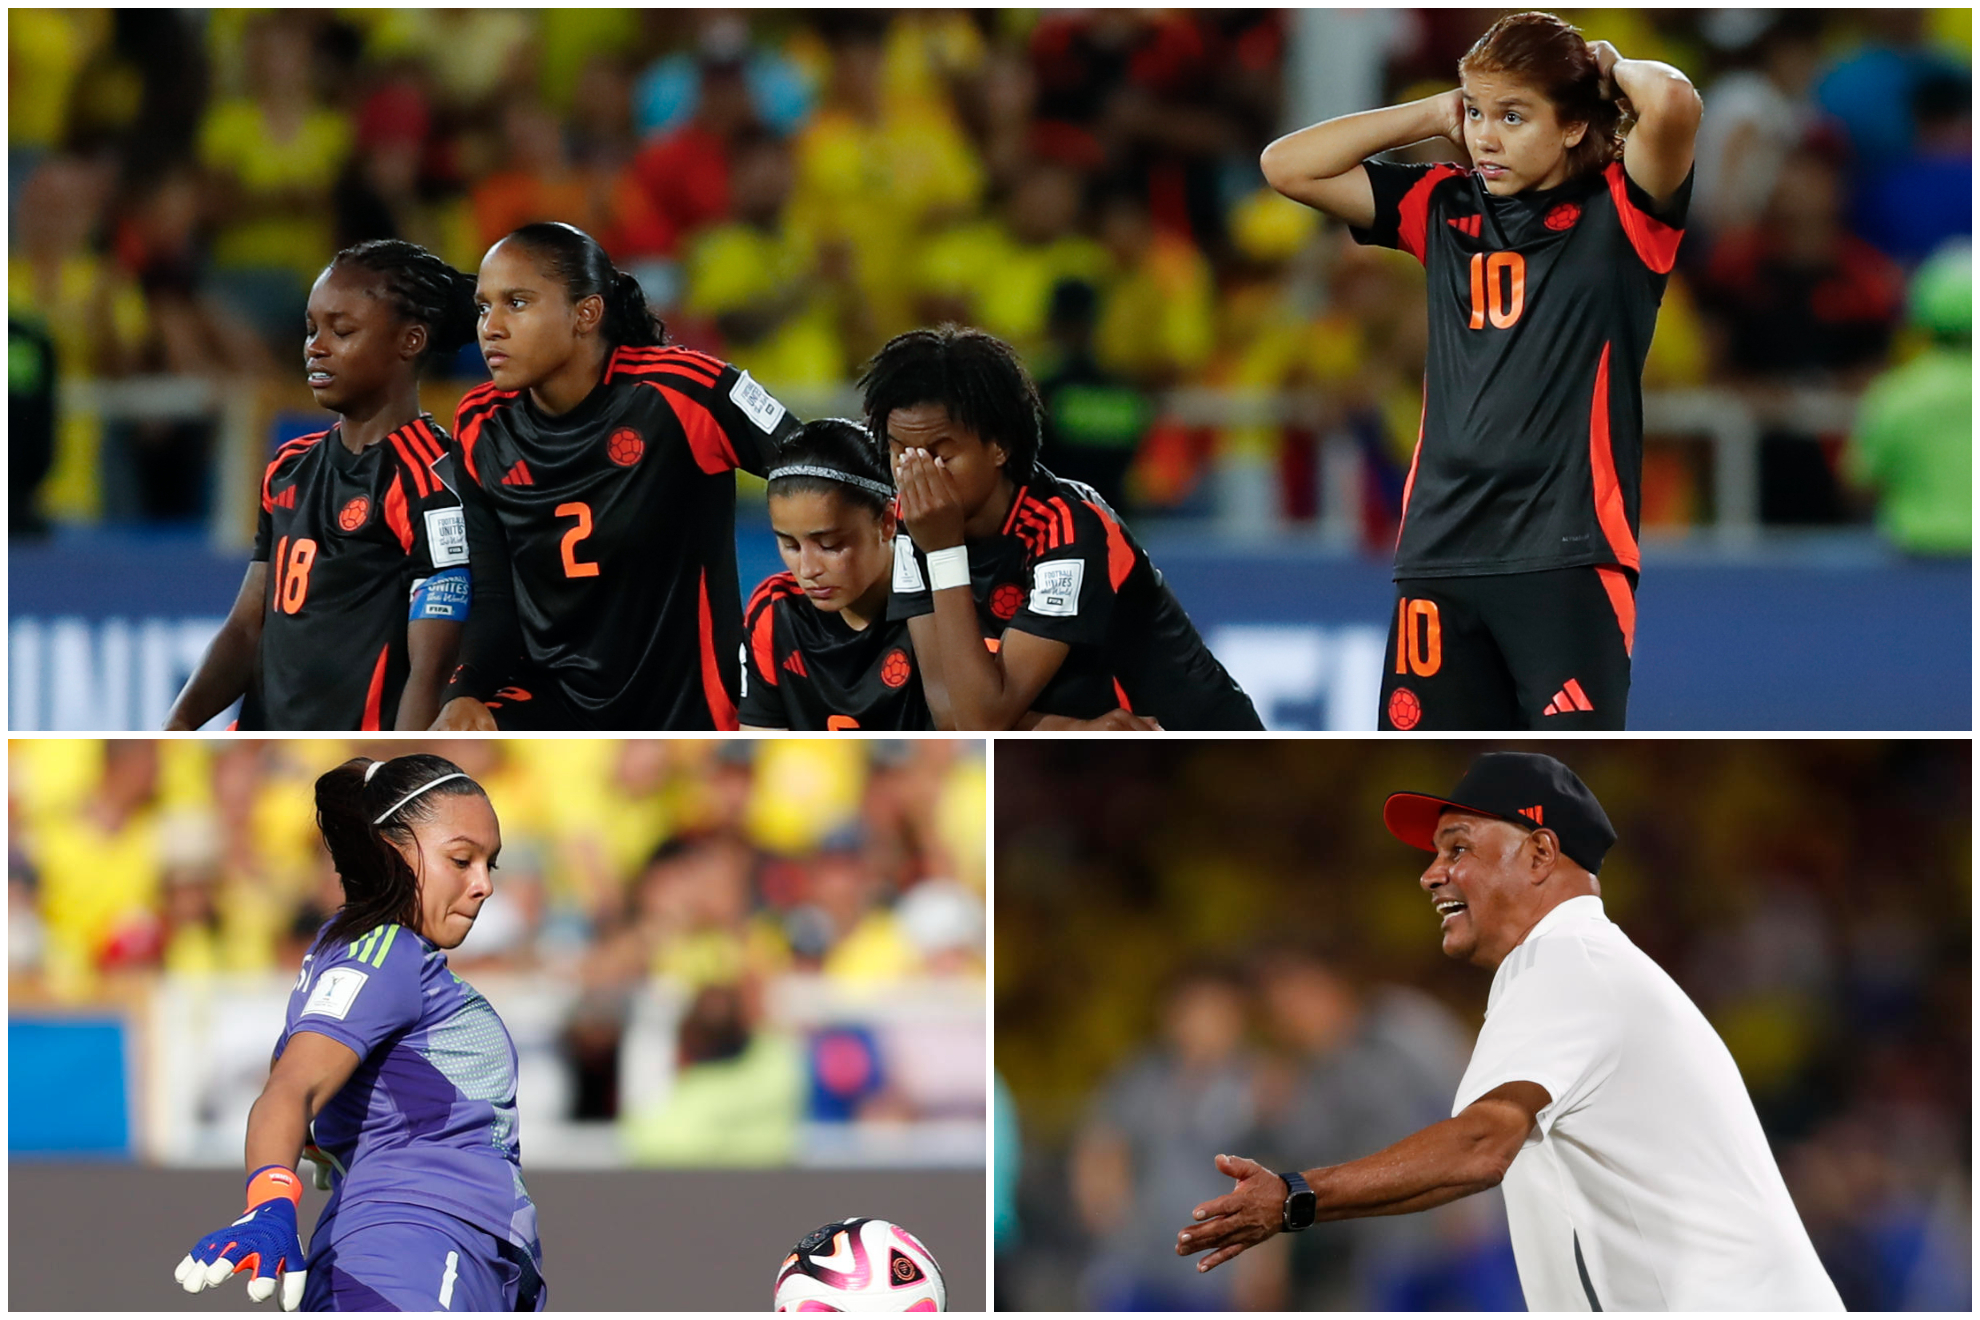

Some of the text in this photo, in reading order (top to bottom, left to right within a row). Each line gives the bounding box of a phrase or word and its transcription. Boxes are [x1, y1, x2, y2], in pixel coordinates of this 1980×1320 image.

[1469, 251, 1525, 329] 10
[274, 535, 317, 615] 18
[555, 502, 599, 578] 2
[428, 582, 469, 595] UNITES
[1396, 597, 1441, 677] 10
